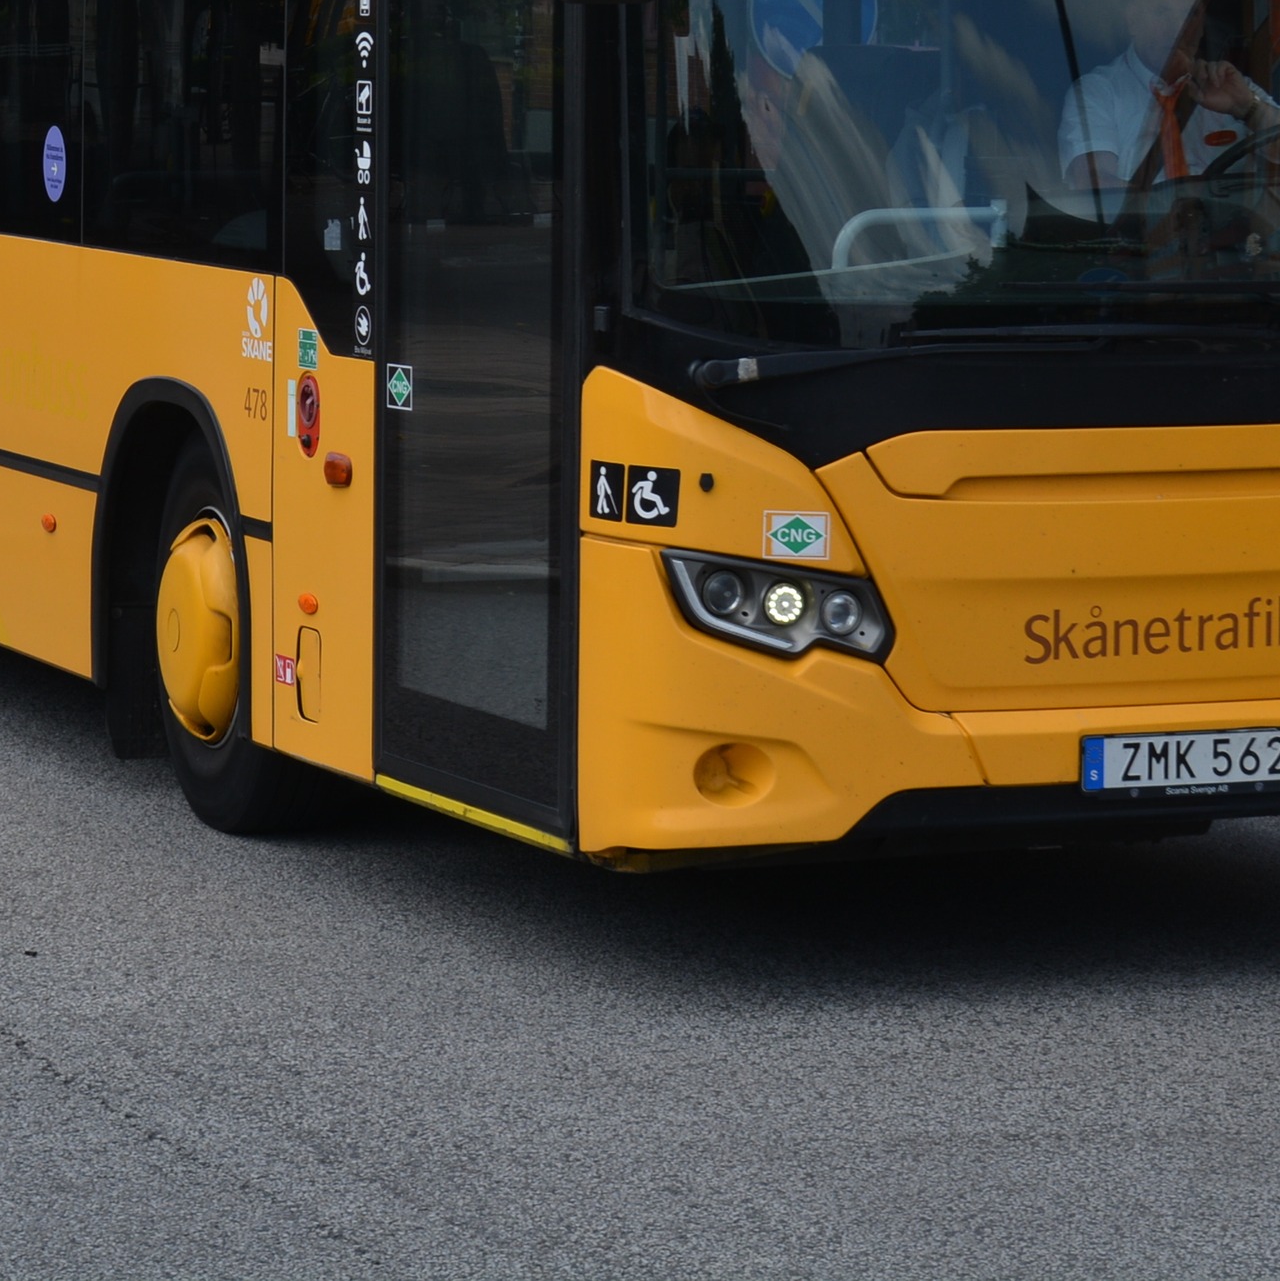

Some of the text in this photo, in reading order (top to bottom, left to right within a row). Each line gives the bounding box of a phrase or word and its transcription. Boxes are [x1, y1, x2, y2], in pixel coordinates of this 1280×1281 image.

[391, 379, 408, 394] CNG
[244, 387, 268, 421] 478
[777, 527, 817, 543] CNG
[1121, 739, 1196, 782] ZMK
[1090, 770, 1099, 781] S
[1165, 783, 1229, 796] Scania Sverige AB
